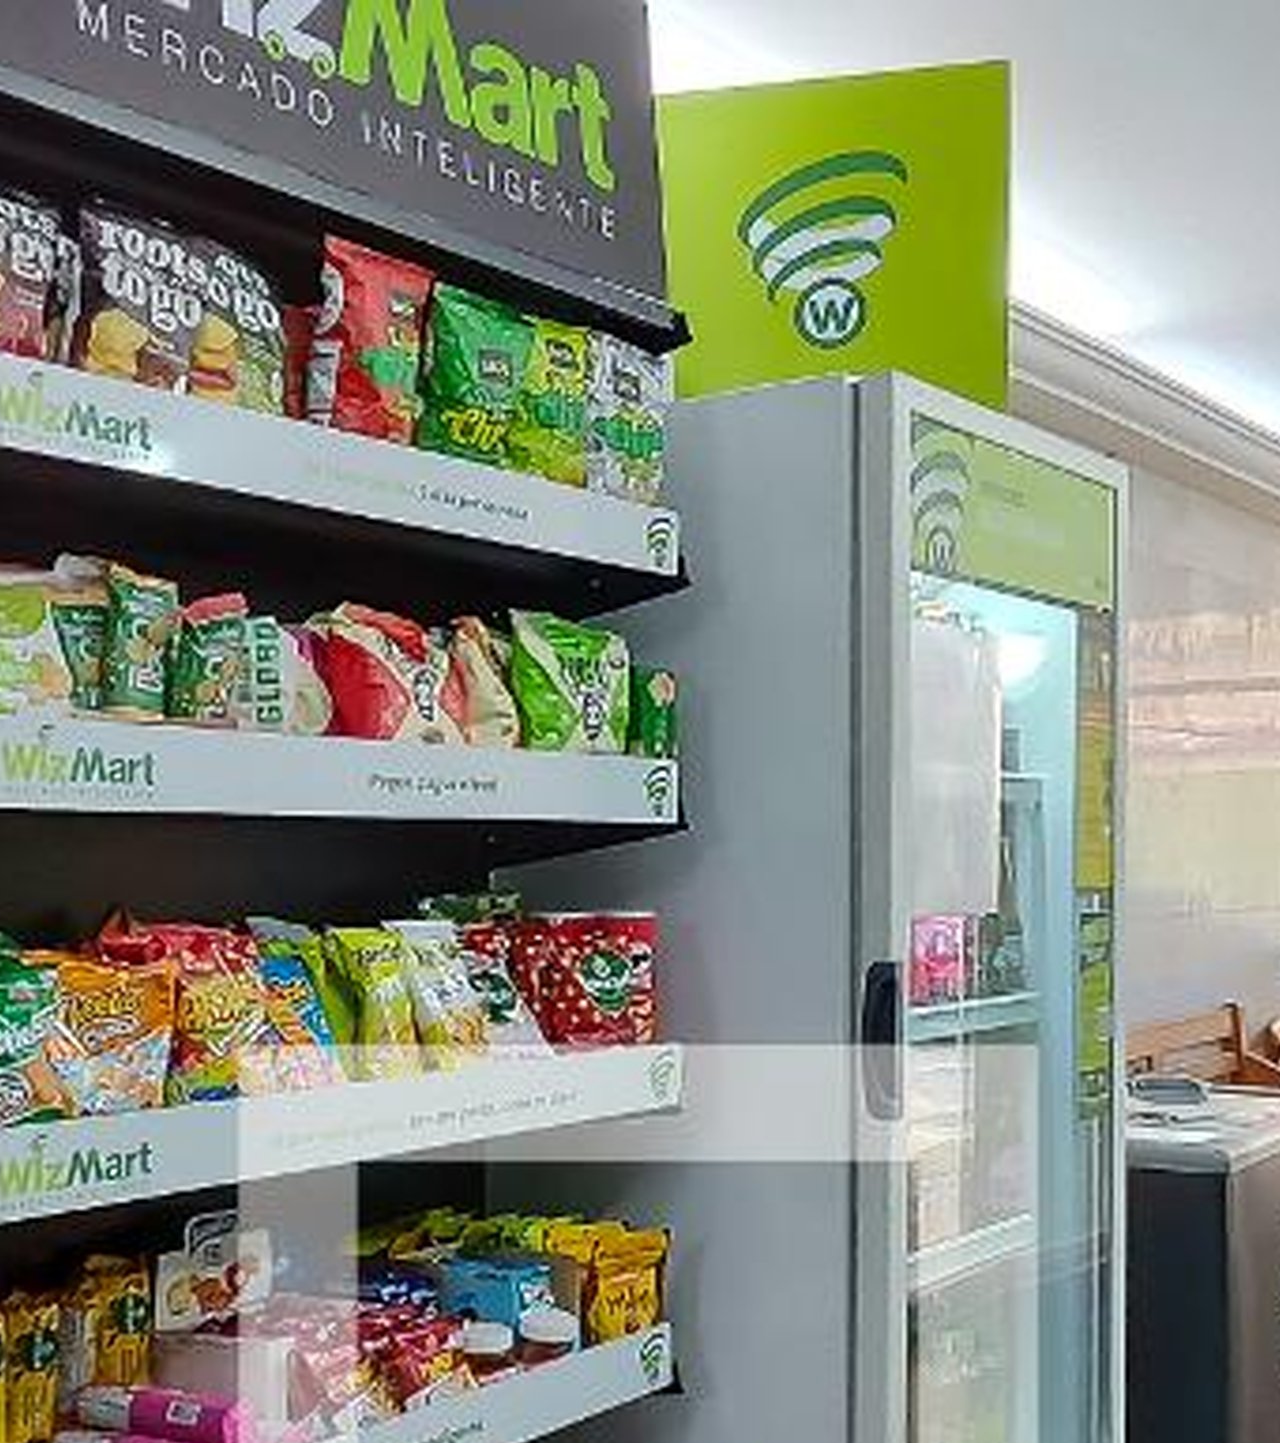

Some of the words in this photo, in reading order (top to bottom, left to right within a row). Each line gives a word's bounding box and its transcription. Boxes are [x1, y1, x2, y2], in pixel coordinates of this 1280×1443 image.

[79, 2, 334, 127] MERCADO
[361, 112, 617, 240] INTELIGENTE
[97, 218, 210, 284] roots
[101, 249, 150, 300] to
[151, 278, 203, 333] go
[255, 619, 283, 728] GLOBO
[1, 728, 155, 788] WizMart
